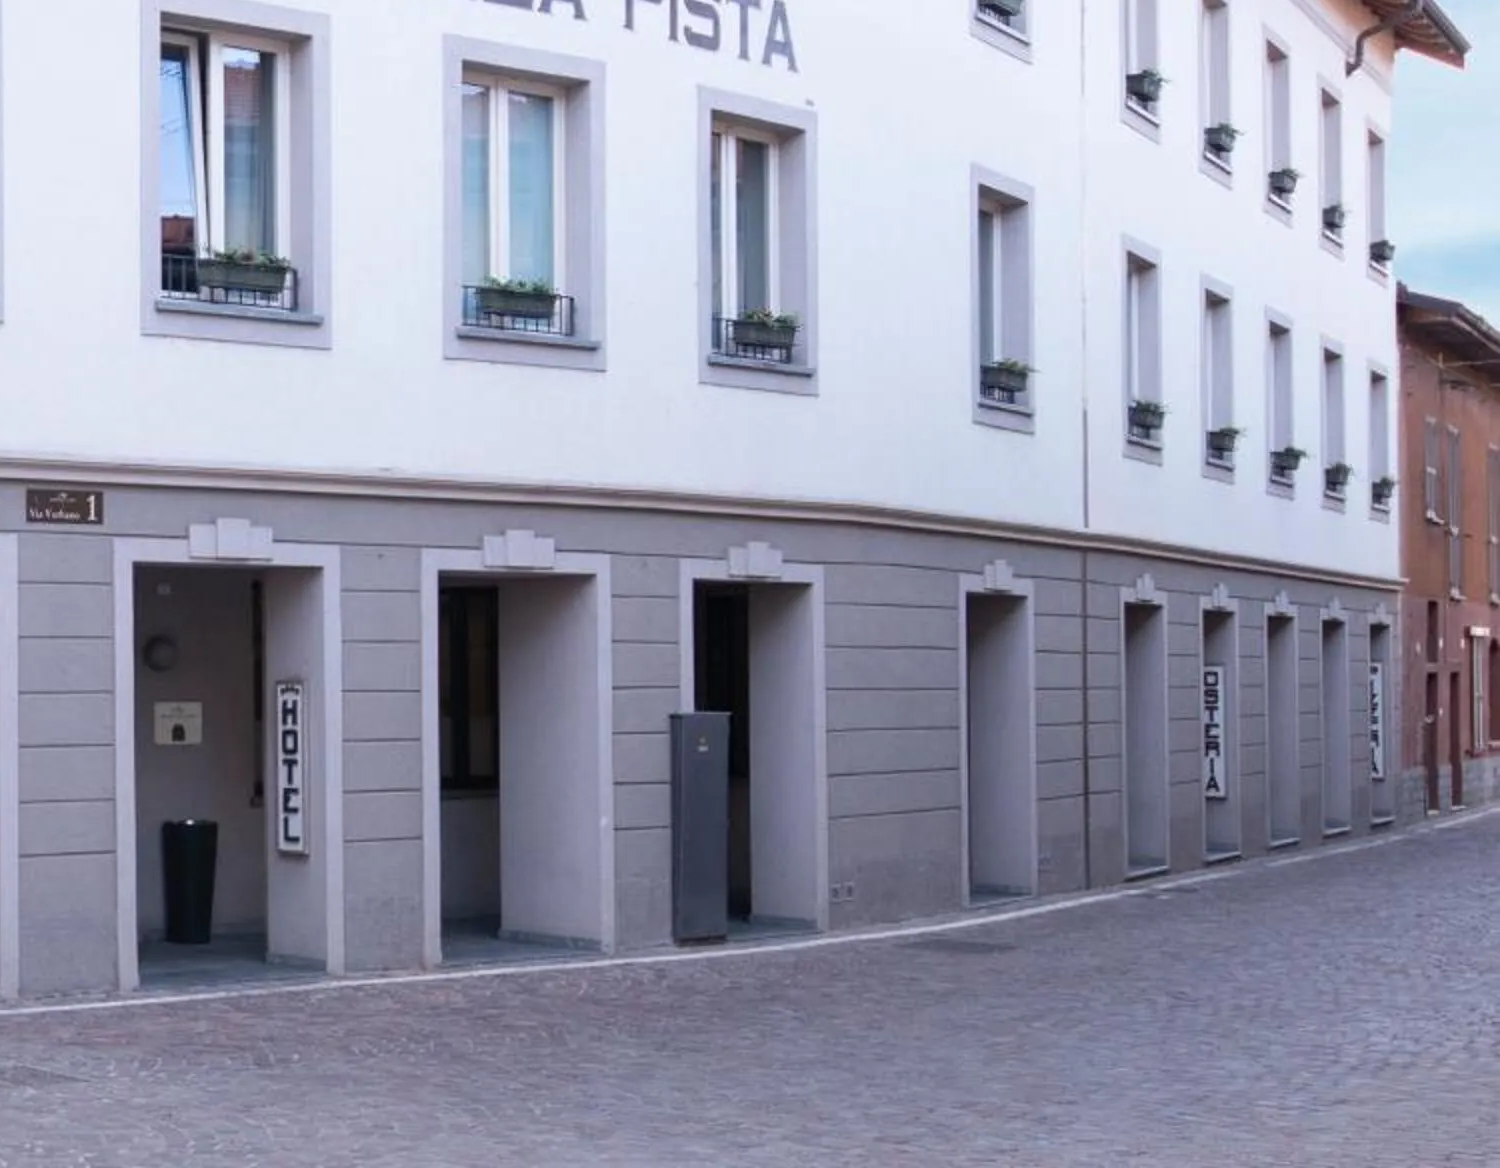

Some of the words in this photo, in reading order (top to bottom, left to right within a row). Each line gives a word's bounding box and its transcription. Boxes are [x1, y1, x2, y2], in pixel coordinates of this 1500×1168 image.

[29, 506, 43, 520] Via
[86, 494, 98, 521] 1
[1203, 670, 1220, 793] OSTERIA
[281, 698, 301, 844] HOTEL
